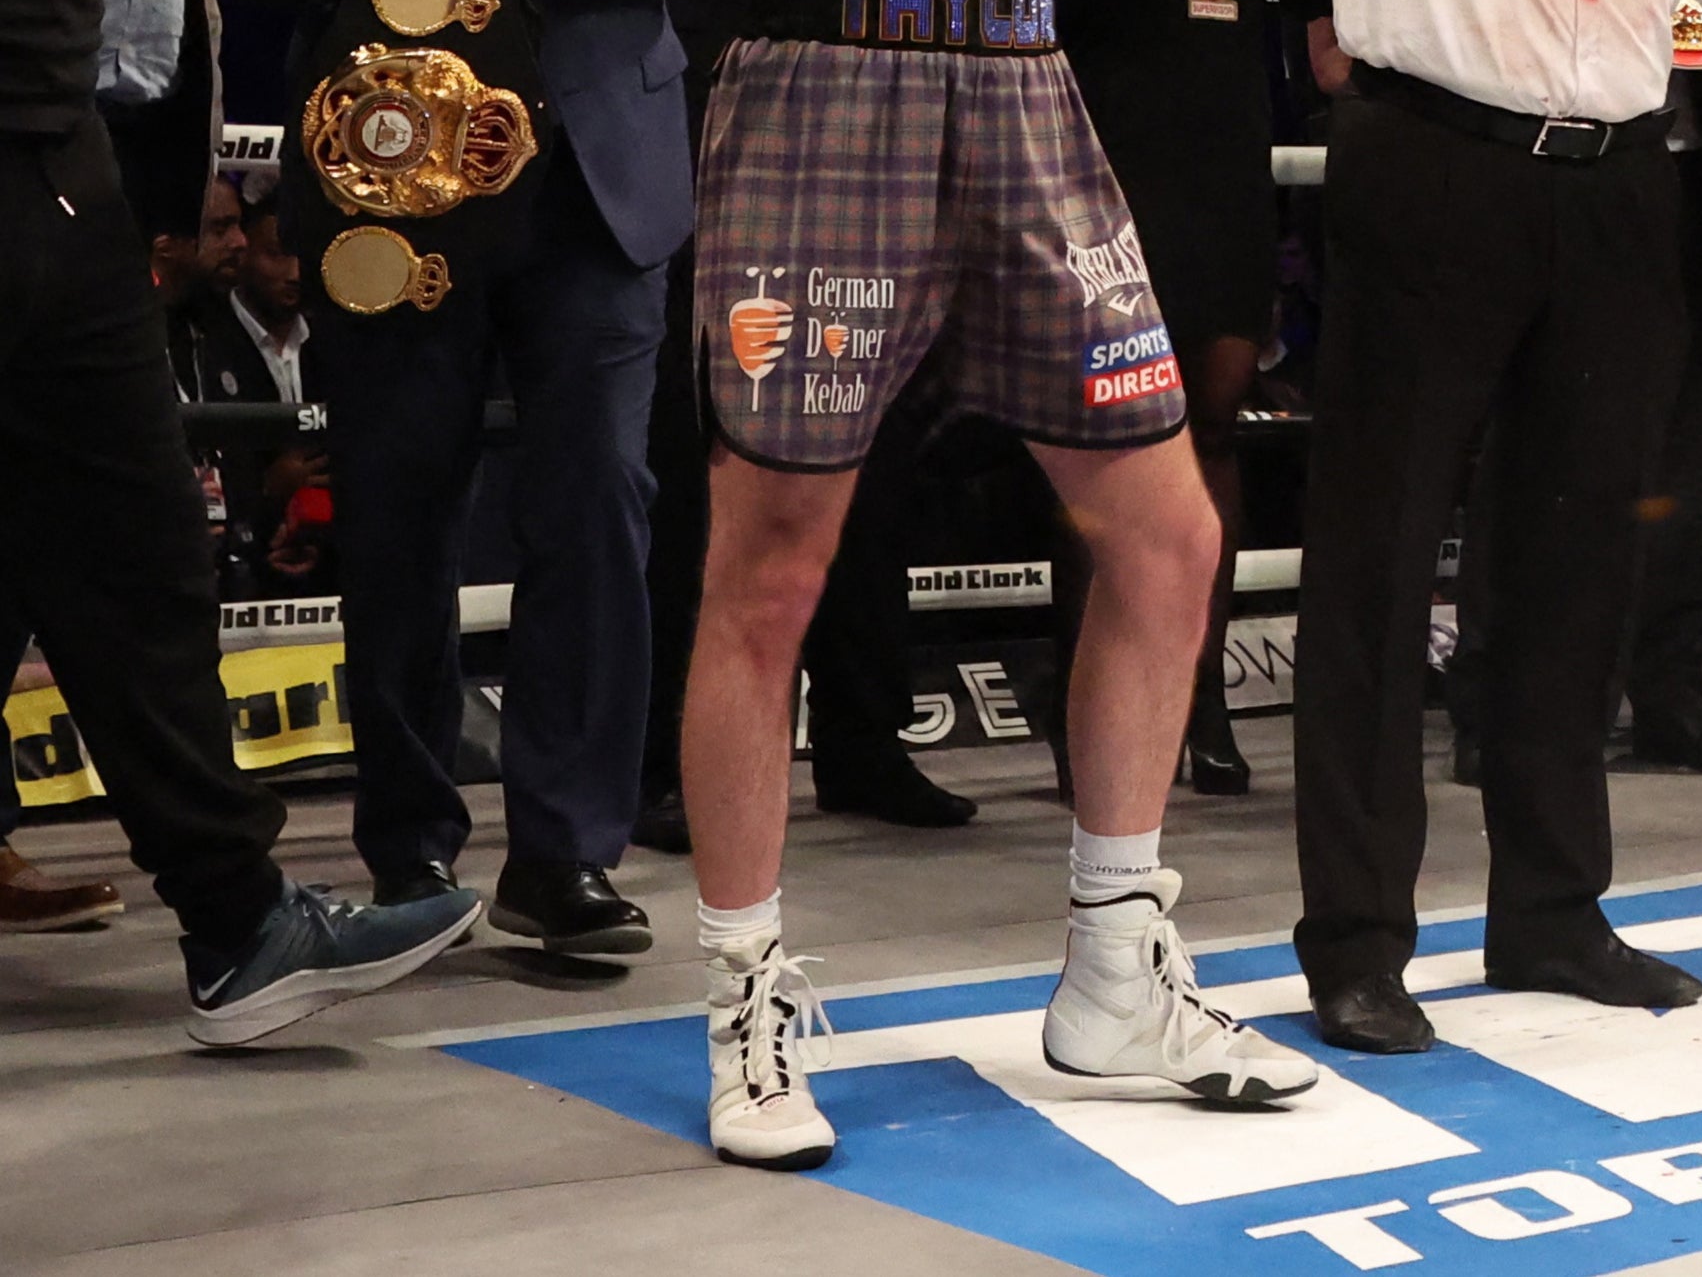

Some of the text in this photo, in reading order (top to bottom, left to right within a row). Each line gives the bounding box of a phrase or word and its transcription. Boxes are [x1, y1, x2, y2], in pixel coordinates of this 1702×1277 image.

[1066, 221, 1150, 308] EVERLAST
[807, 266, 895, 310] German
[1090, 327, 1169, 370] SPORTS
[803, 373, 866, 415] Kebab
[1093, 360, 1178, 404] DIRECT
[966, 567, 1045, 589] Clark
